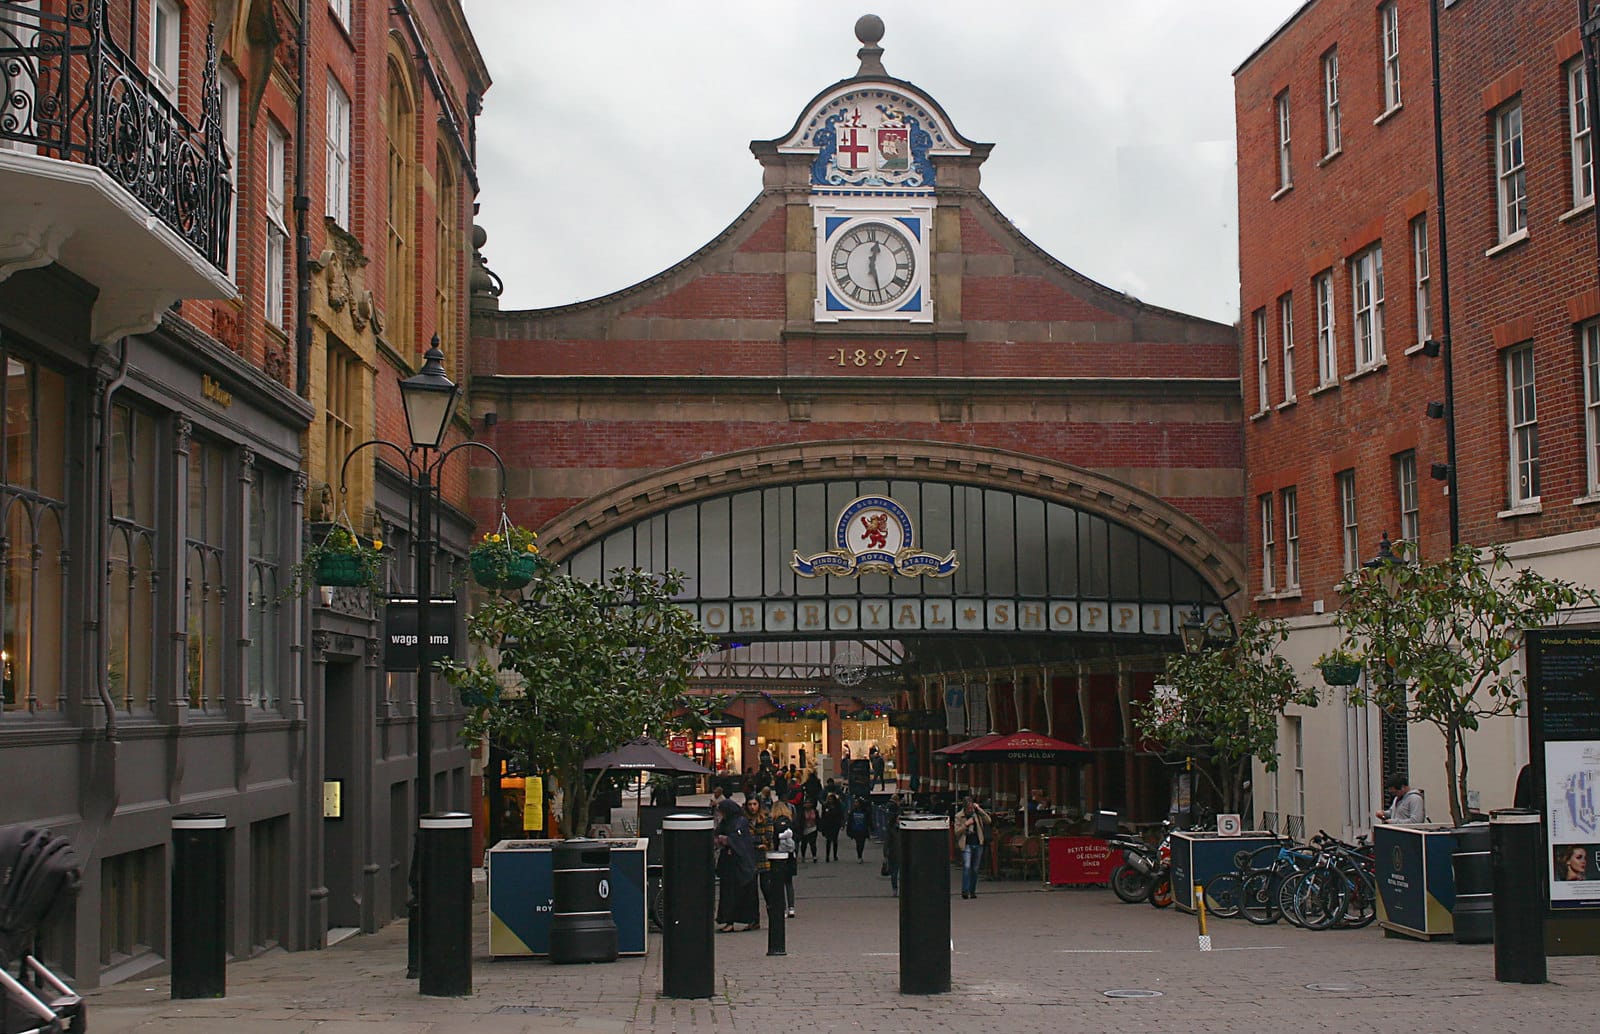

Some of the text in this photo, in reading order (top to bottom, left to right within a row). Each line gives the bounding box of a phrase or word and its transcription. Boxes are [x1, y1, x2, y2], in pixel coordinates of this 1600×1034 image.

[812, 554, 940, 567] WINDSOR ROYAL STATION
[804, 604, 946, 626] ROYAL
[1225, 820, 1234, 831] 5
